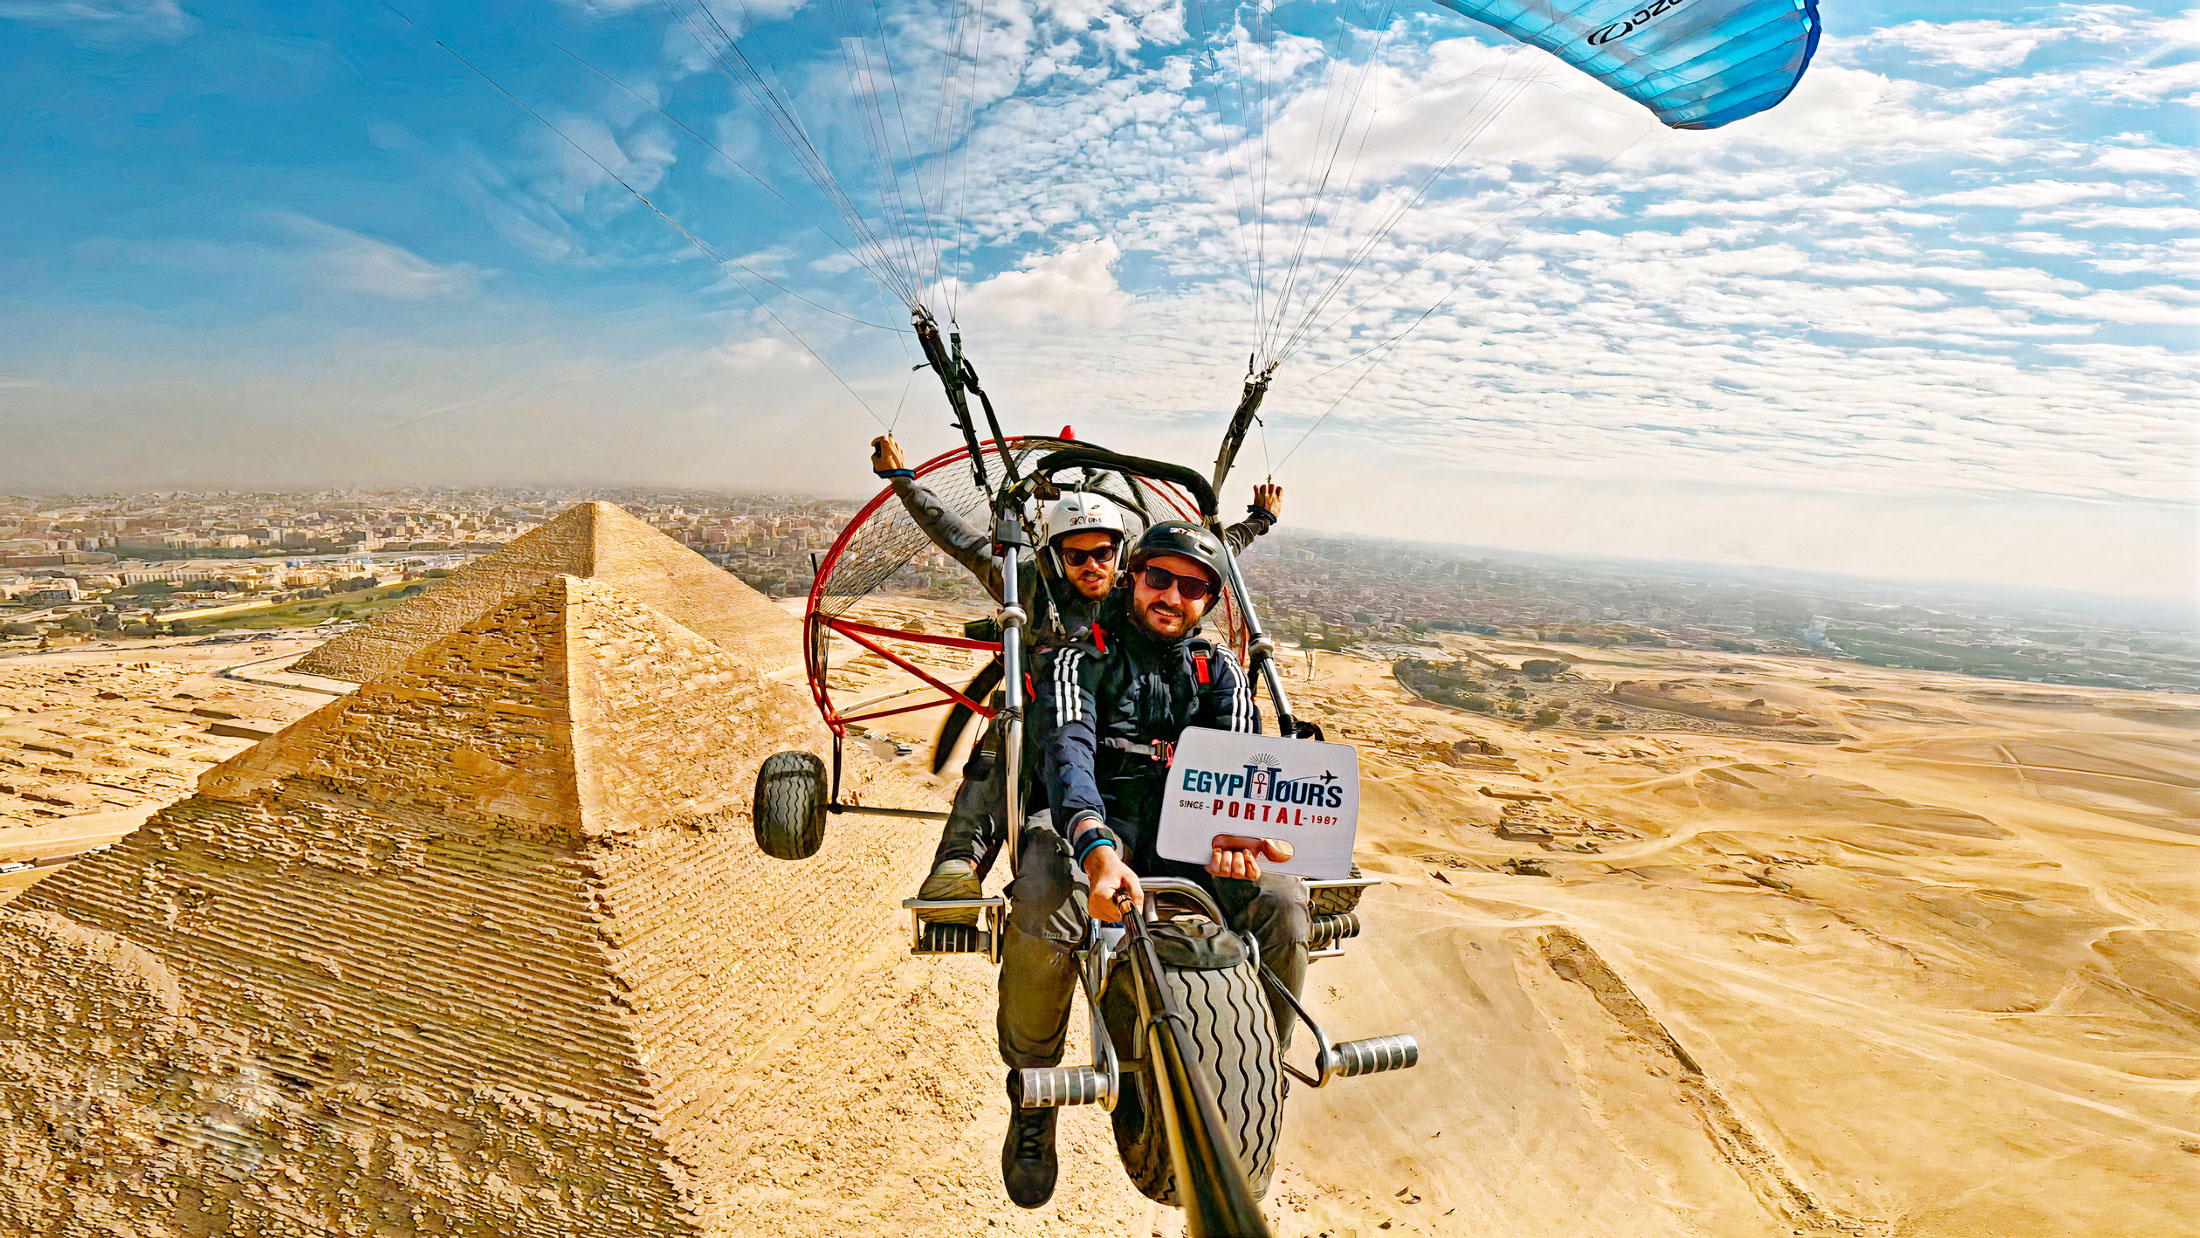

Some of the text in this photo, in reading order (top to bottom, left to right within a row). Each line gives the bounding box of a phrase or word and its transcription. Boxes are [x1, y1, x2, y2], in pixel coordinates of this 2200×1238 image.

[1182, 764, 1343, 809] EGYPT TOURS
[1212, 799, 1304, 826] PORTAL
